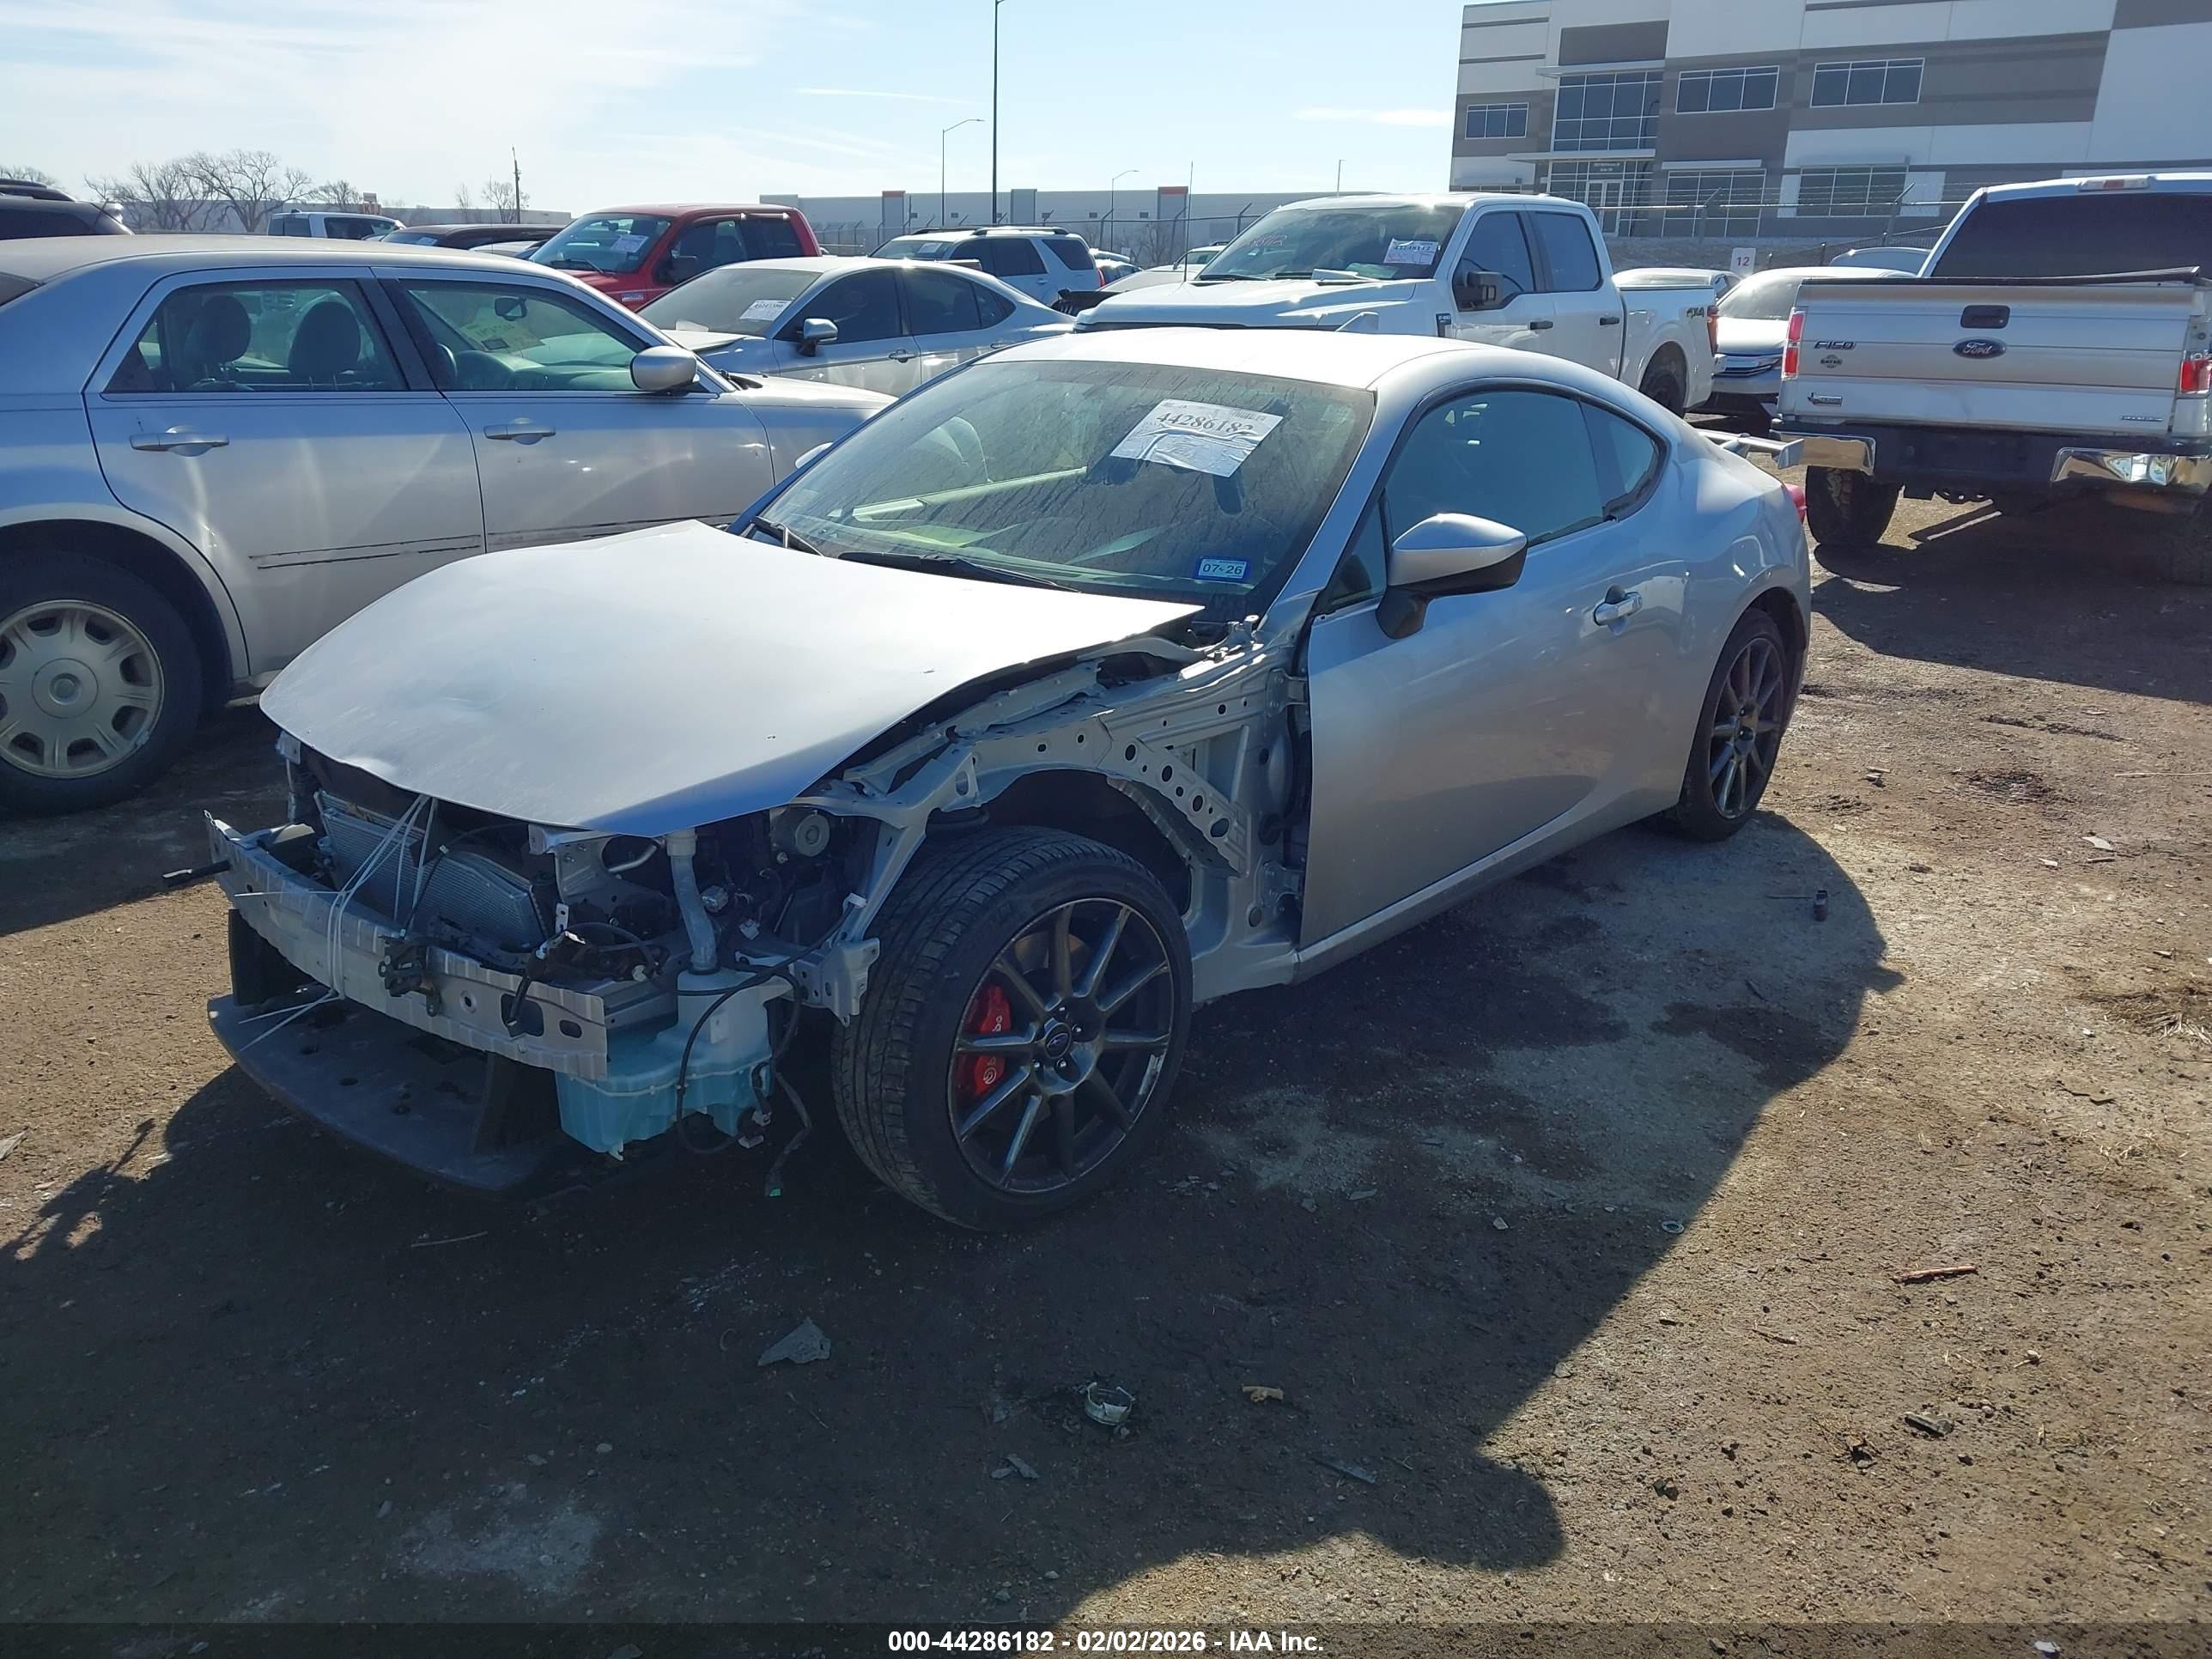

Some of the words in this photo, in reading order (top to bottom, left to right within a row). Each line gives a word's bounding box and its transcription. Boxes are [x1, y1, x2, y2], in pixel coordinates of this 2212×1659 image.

[1736, 256, 1751, 267] 12
[1962, 342, 1993, 355] Ford
[1202, 563, 1243, 575] 07-26
